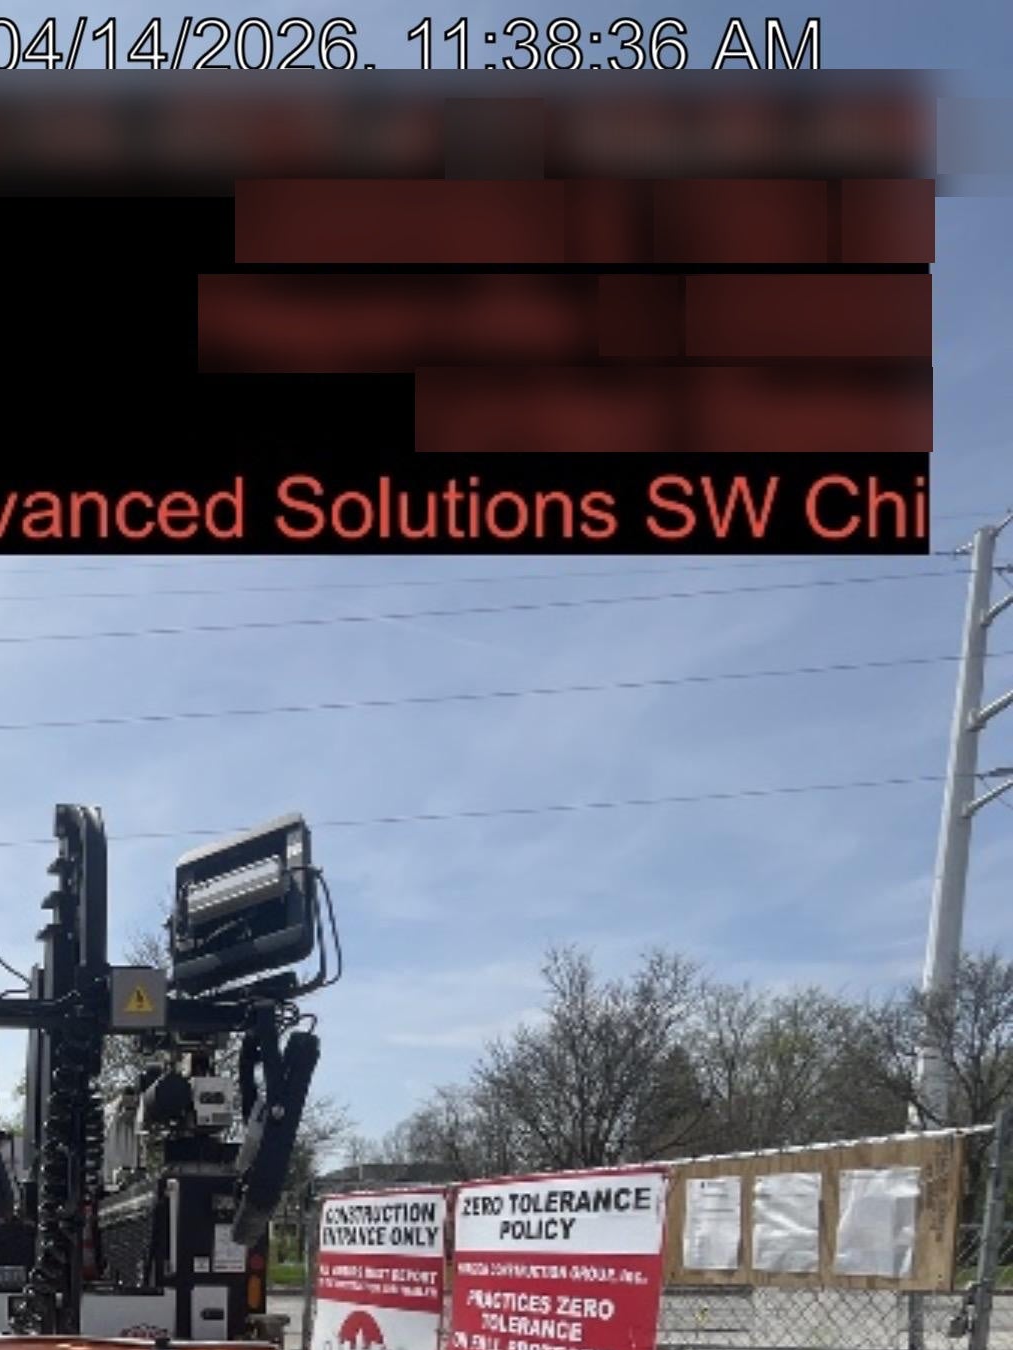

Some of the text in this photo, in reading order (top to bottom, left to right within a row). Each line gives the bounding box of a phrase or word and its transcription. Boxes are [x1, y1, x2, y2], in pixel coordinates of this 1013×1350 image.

[462, 1187, 652, 1217] ZERO TOLERANCE
[391, 1226, 439, 1247] ONLY
[499, 1218, 576, 1240] POLICY
[467, 1288, 616, 1321] PRACTICES ZERO
[481, 1313, 583, 1342] TOLERANCE
